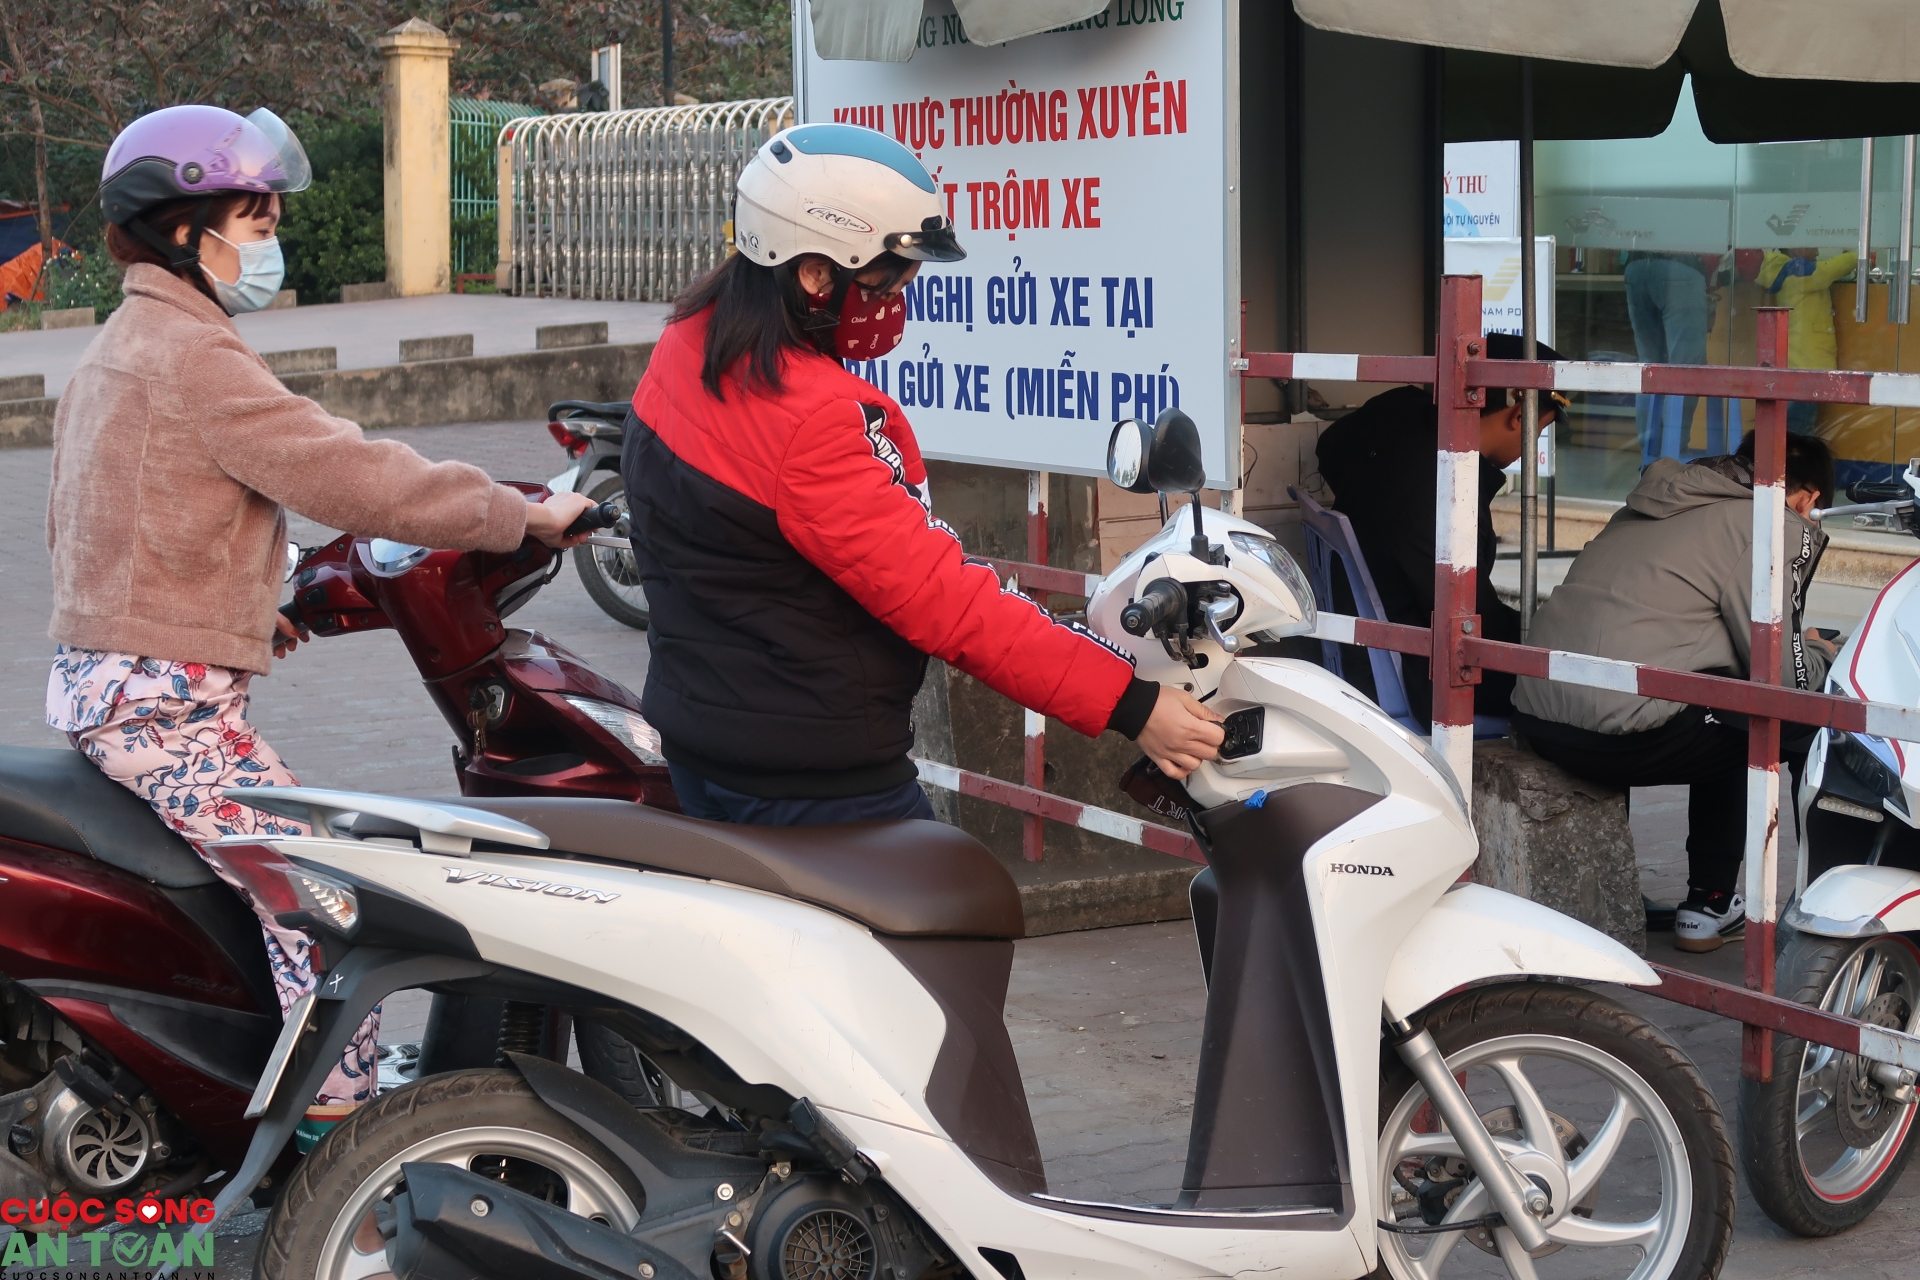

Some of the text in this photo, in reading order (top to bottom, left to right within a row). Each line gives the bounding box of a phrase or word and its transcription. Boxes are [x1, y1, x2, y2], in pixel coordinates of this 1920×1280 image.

[1117, 0, 1184, 26] LONG
[949, 80, 1068, 147] THƯỜNG
[1077, 70, 1187, 140] XUYÊN
[1456, 175, 1488, 194] THU
[966, 168, 1050, 241] TRỘM
[1061, 177, 1101, 229] XE
[1467, 212, 1500, 227] NGUYỆN
[905, 255, 1153, 339] NGHỊ GỬI XE TẠI
[898, 342, 944, 409] GỬI
[953, 363, 990, 413] XE
[1005, 349, 1099, 421] (MIỄN
[1792, 632, 1803, 668] STAND
[441, 866, 622, 904] VISION
[1330, 862, 1395, 877] HONDA
